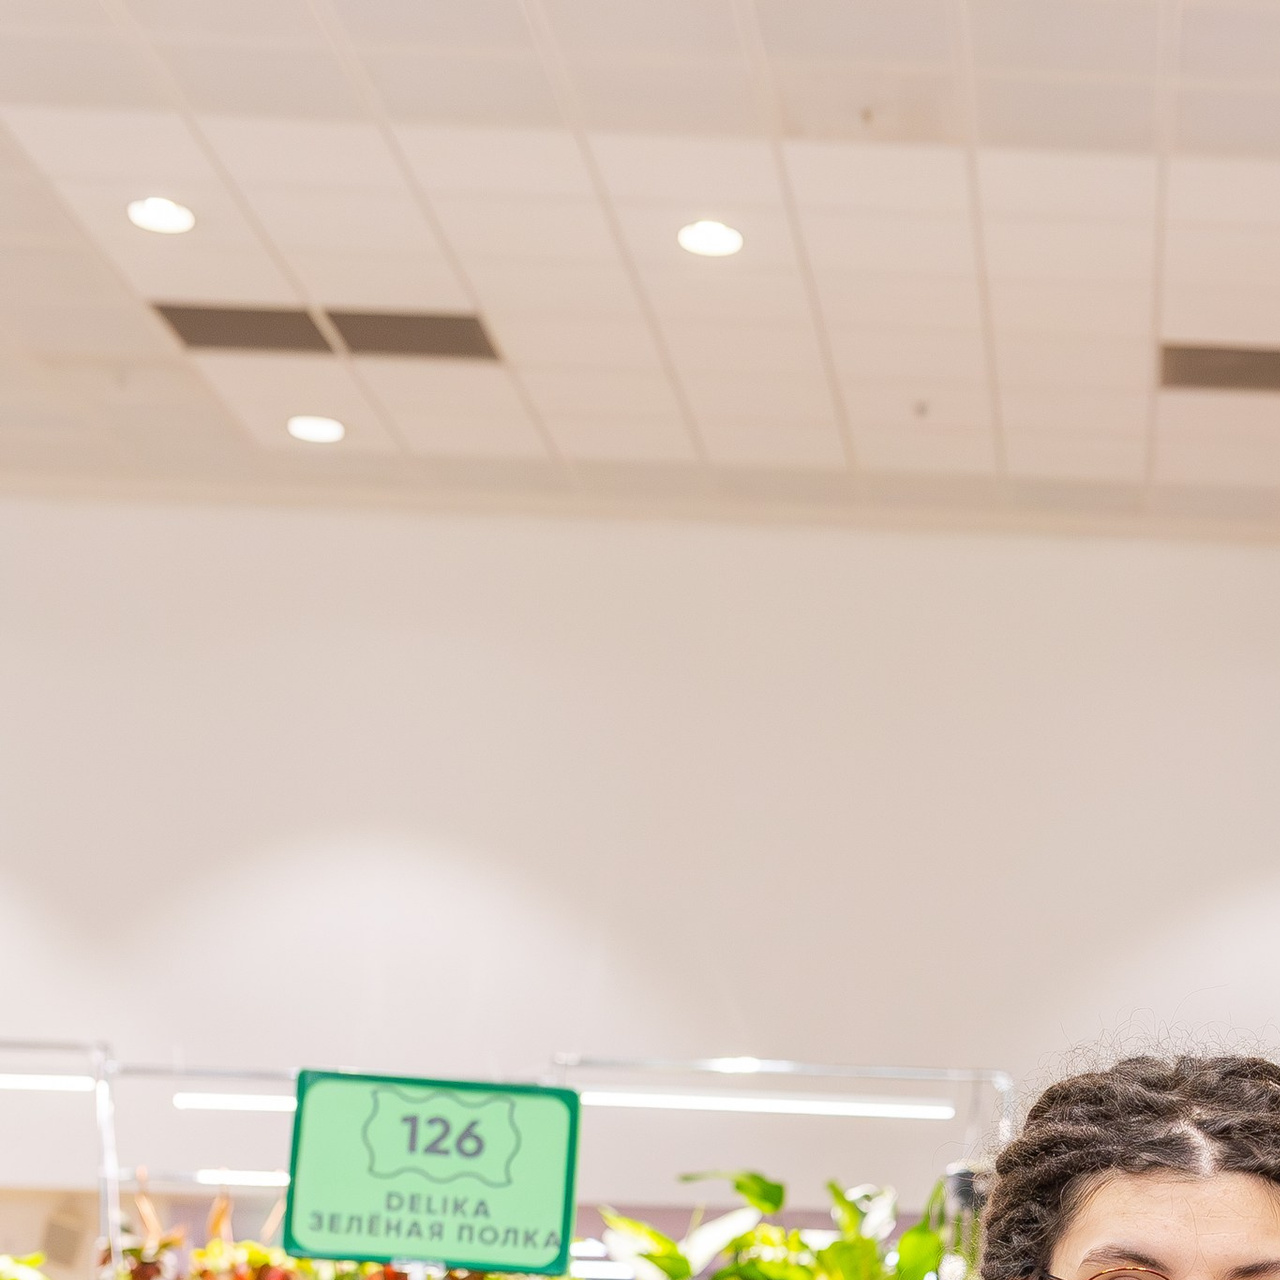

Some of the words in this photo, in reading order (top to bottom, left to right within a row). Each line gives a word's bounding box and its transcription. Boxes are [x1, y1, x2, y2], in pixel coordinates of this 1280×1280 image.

[400, 1113, 486, 1159] 126
[385, 1191, 491, 1219] DELIKA
[308, 1209, 444, 1242] ЗЕЛЁНАЯ
[457, 1225, 561, 1250] ПОЛКА
